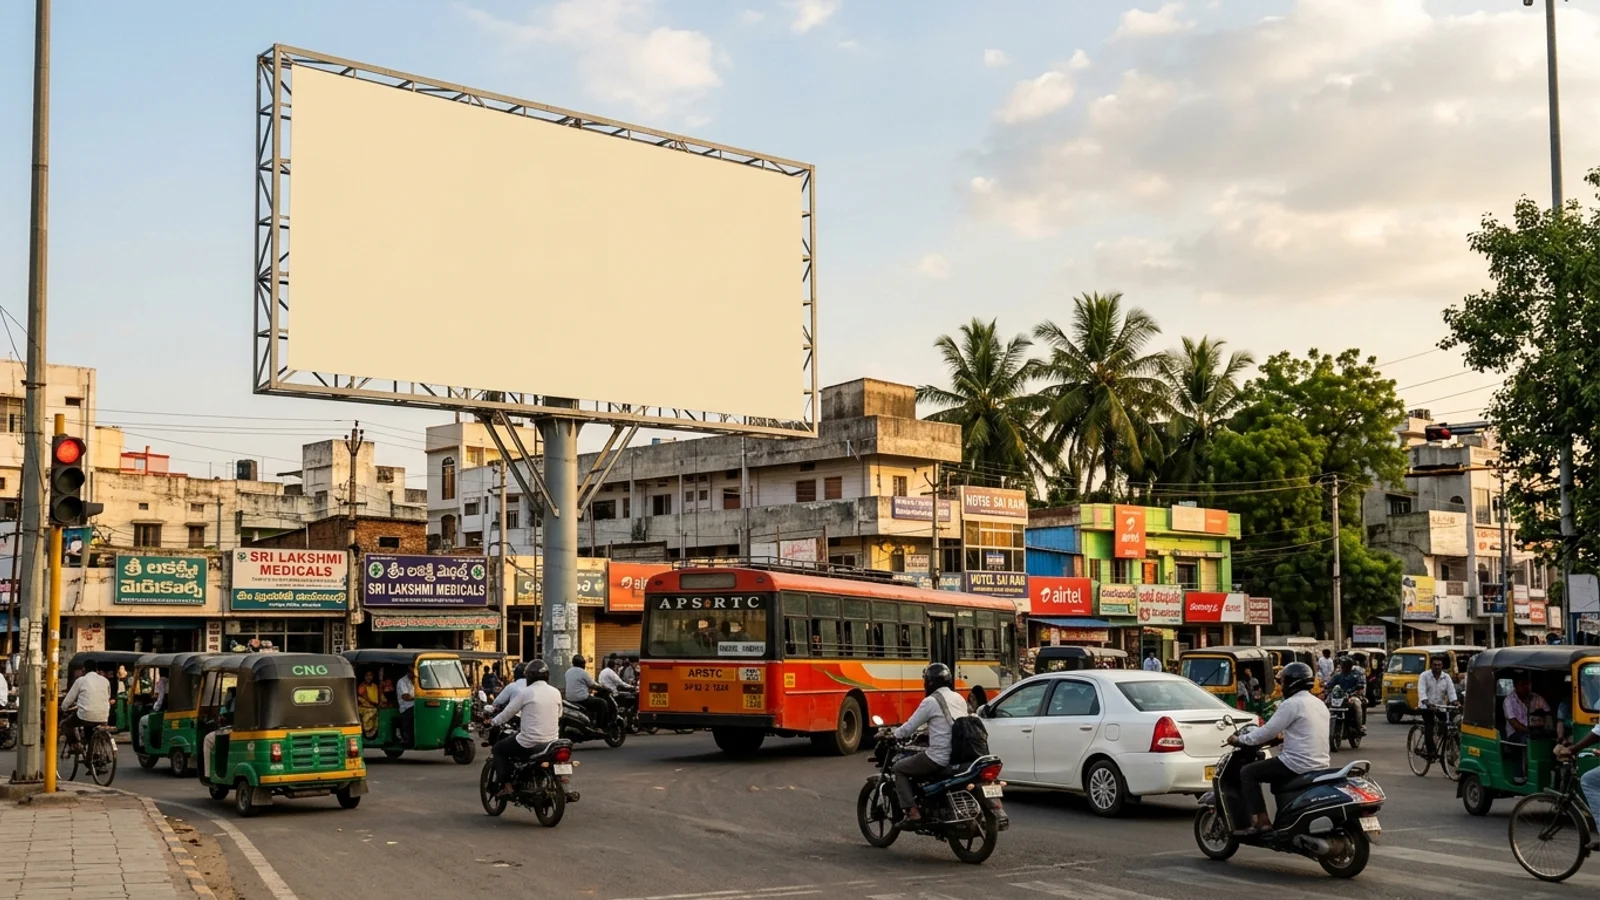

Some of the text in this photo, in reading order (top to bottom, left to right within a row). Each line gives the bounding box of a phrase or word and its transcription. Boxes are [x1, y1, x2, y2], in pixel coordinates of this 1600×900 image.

[250, 551, 342, 564] SRI LAKSHMI
[260, 565, 332, 577] MEDICALS
[368, 582, 385, 595] SRI
[388, 583, 433, 595] LAKSHMI
[1052, 585, 1083, 604] airtel
[292, 665, 328, 675] CNG
